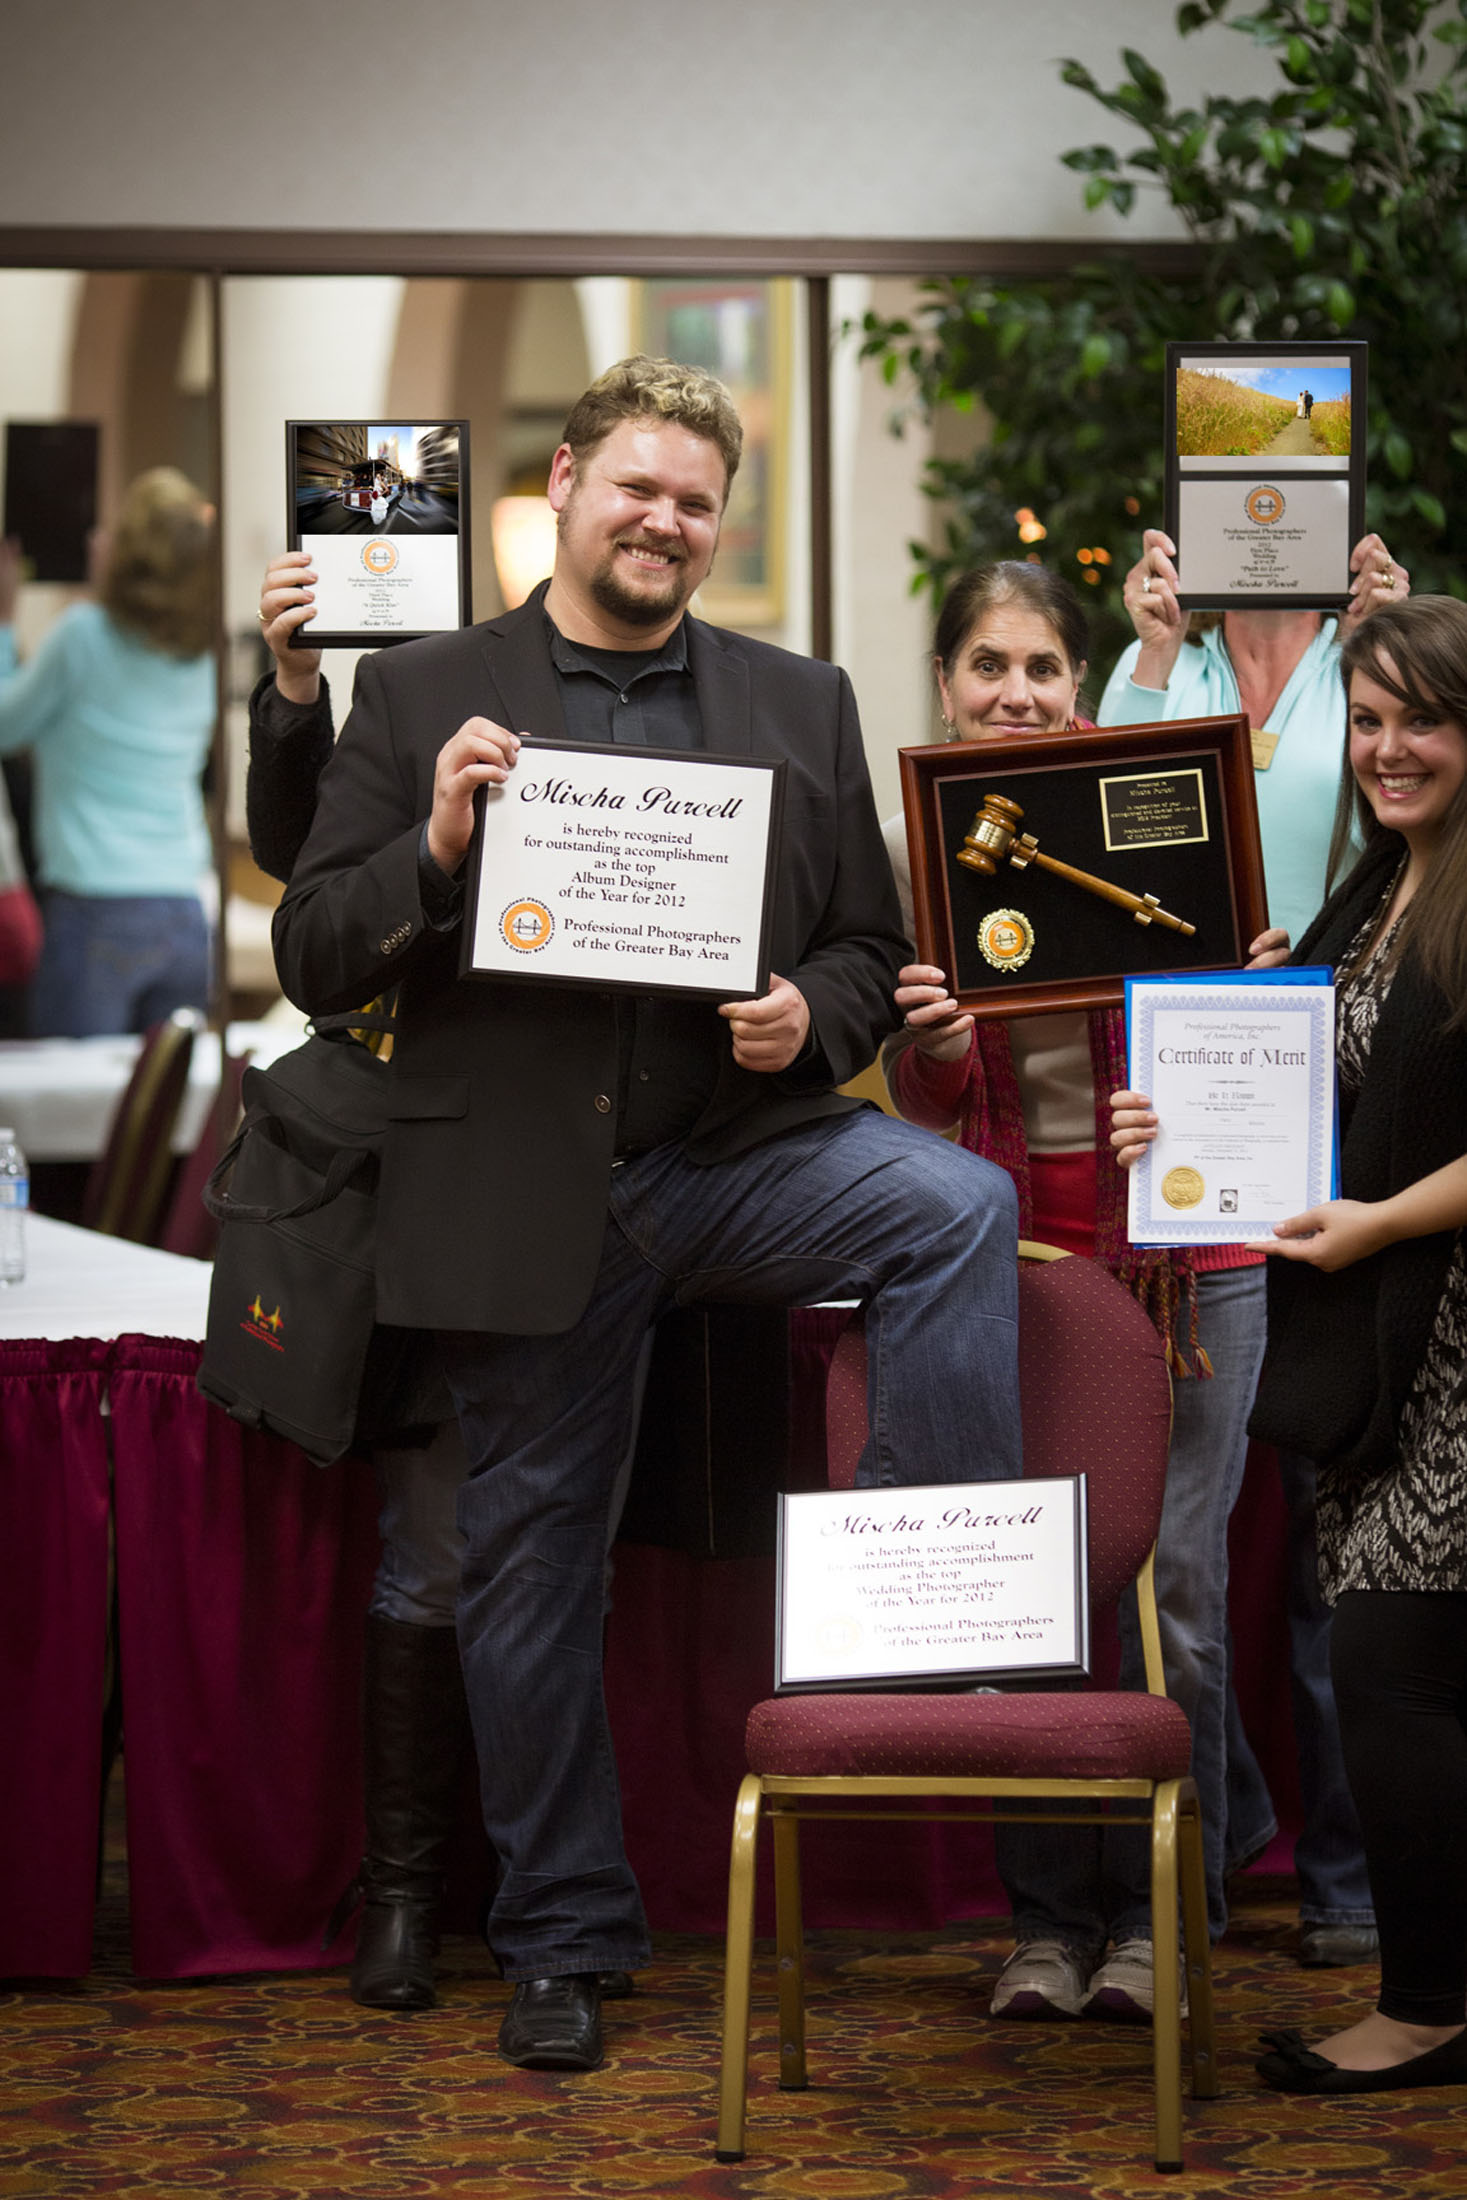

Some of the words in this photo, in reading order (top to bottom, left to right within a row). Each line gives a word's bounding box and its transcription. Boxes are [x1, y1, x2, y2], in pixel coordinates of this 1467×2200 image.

[520, 777, 629, 810] Mischa
[636, 786, 744, 819] Purcell
[563, 822, 573, 834] is
[577, 824, 620, 841] hereby
[624, 831, 693, 846] recognized
[524, 835, 543, 848] for
[546, 839, 621, 857] outstanding
[624, 846, 729, 864] accomplishment
[594, 860, 607, 869] as
[611, 858, 631, 871] the
[635, 862, 656, 876] top
[572, 871, 615, 886] Album
[620, 874, 677, 891] Designer
[558, 886, 574, 898] of
[576, 887, 596, 900] the
[600, 888, 628, 903] Year
[632, 891, 651, 905] for
[654, 894, 686, 908] 2012
[564, 918, 643, 936] Professional
[647, 925, 741, 944] Photographers
[572, 936, 588, 948] of
[590, 938, 611, 951] the
[614, 940, 665, 955] Greater
[668, 944, 694, 960] Bay
[697, 948, 730, 961] Area
[1184, 1022, 1227, 1032] Professional
[1230, 1023, 1281, 1034] Photographers
[1158, 1047, 1234, 1065] Certificate
[1240, 1048, 1255, 1065] of
[1259, 1048, 1307, 1068] Merit
[820, 1513, 925, 1537] Mischa
[936, 1506, 1043, 1530] Purcell
[879, 1545, 921, 1558] hereby
[926, 1540, 996, 1554] recognized
[928, 1552, 1034, 1568] accomplishment
[899, 1572, 912, 1581] as
[916, 1570, 936, 1580] the
[941, 1569, 962, 1580] top
[917, 1579, 1005, 1594] Photographer
[883, 1597, 903, 1608] the
[908, 1596, 936, 1606] Year
[940, 1594, 959, 1605] for
[963, 1592, 995, 1603] 2012
[958, 1616, 1055, 1630] Photographers
[901, 1636, 922, 1647] the
[926, 1633, 978, 1645] Greater
[981, 1631, 1006, 1644] Bay
[1011, 1630, 1044, 1641] Area
